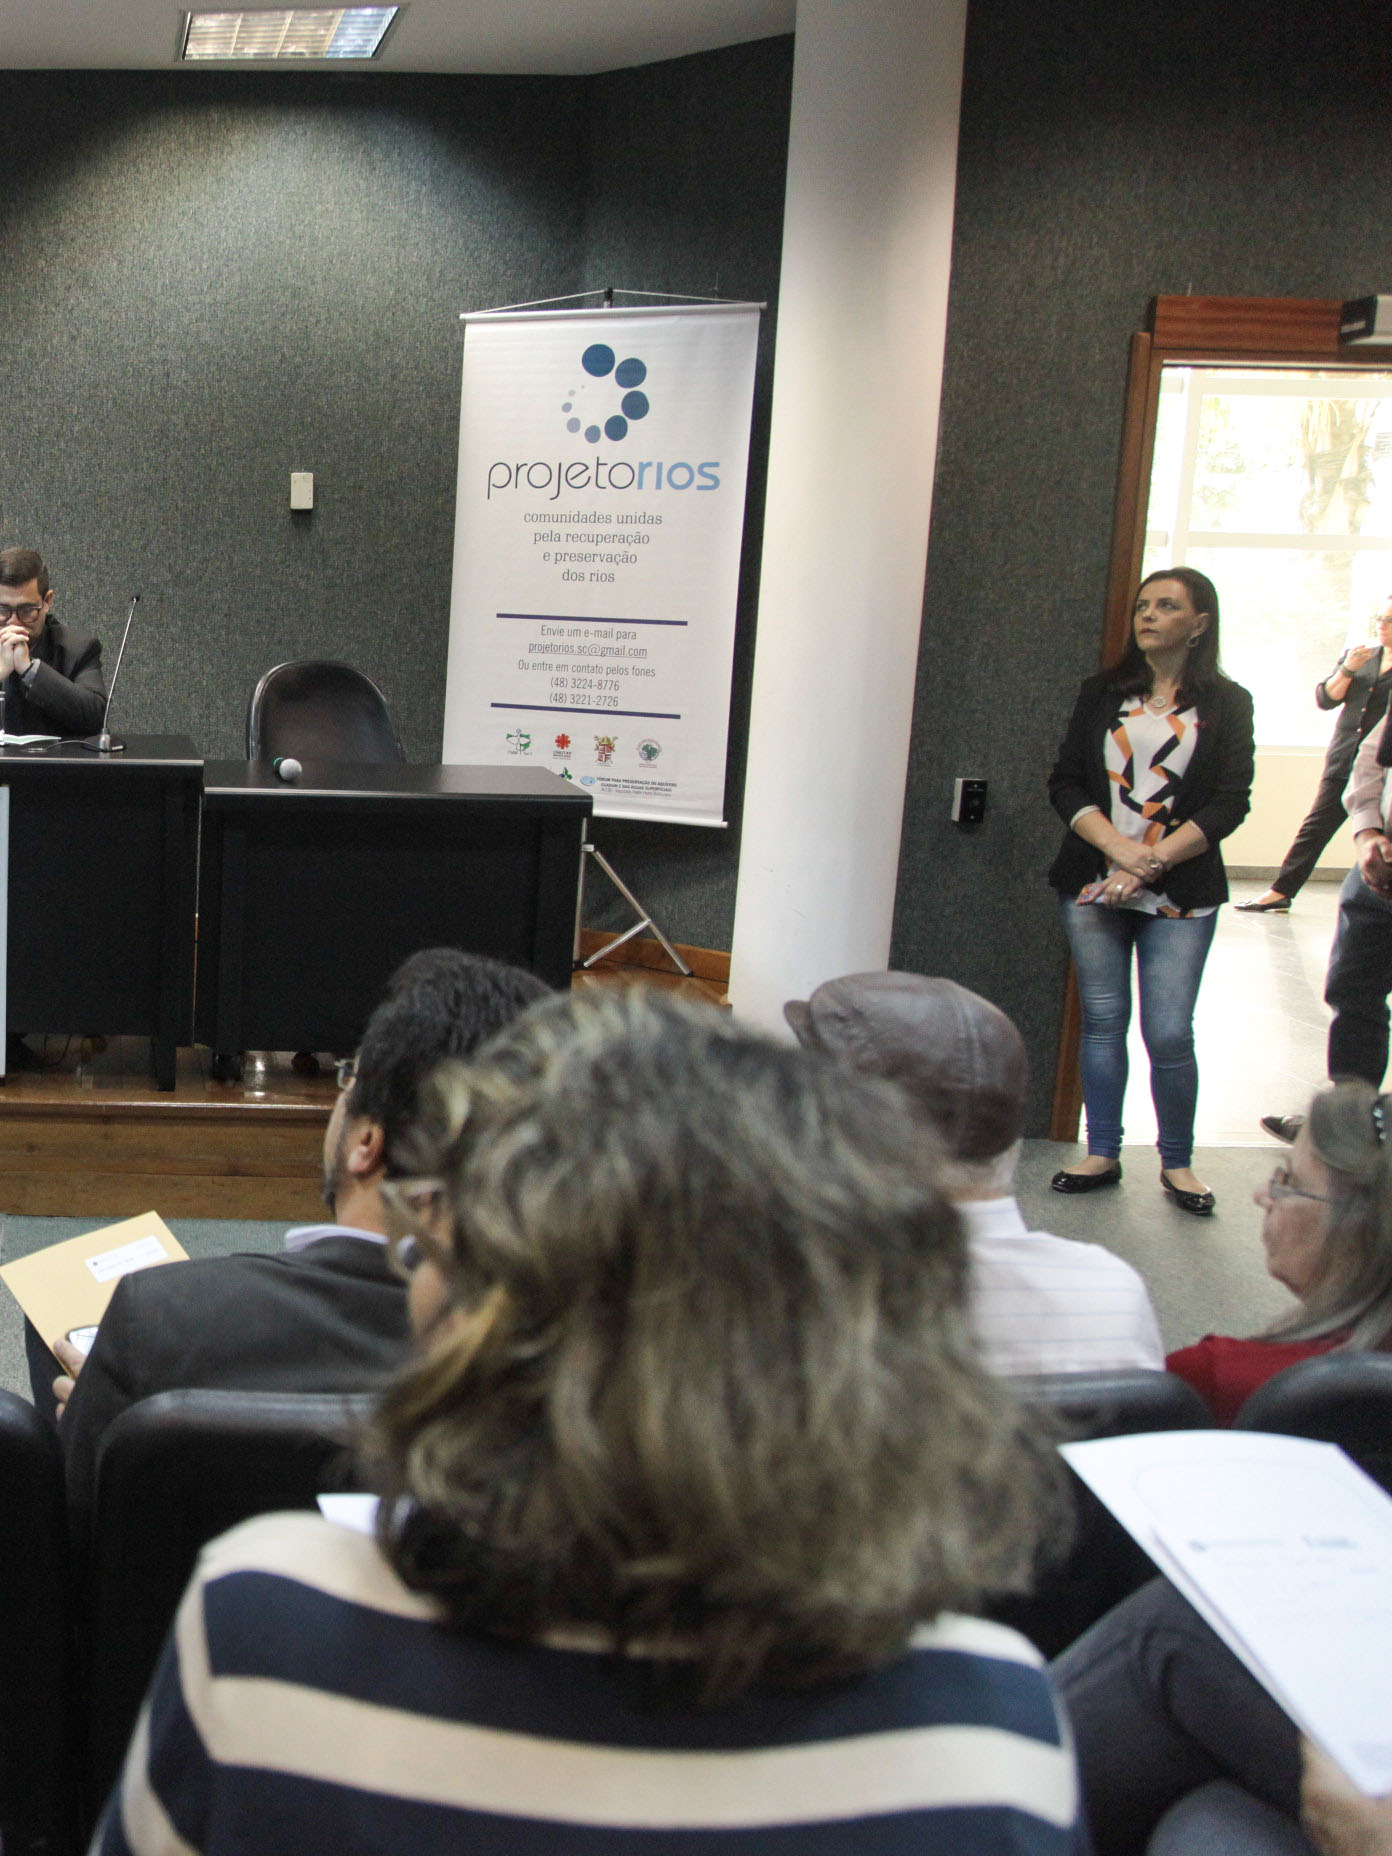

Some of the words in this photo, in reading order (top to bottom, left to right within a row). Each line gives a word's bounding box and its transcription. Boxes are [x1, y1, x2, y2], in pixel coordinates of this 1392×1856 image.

[487, 456, 721, 500] projetorios
[523, 510, 612, 525] comunidades
[616, 511, 663, 525] unidas
[533, 530, 561, 545] pela
[565, 531, 650, 547] recuperação
[542, 552, 551, 562] e
[554, 550, 638, 566] preservação
[562, 569, 585, 582] dos
[589, 569, 615, 583] rios
[540, 624, 565, 636] Envie
[567, 628, 582, 637] um
[584, 627, 614, 639] e-mail
[616, 630, 637, 641] para
[518, 659, 529, 670] Ou
[532, 661, 554, 672] entre
[555, 663, 569, 672] em
[571, 662, 603, 674] contato
[606, 664, 629, 676] pelos
[631, 665, 656, 677] fones
[550, 676, 568, 689] (48)
[570, 678, 620, 691] 3224-8776
[549, 692, 567, 704] (48)
[570, 694, 619, 707] 3221-2726
